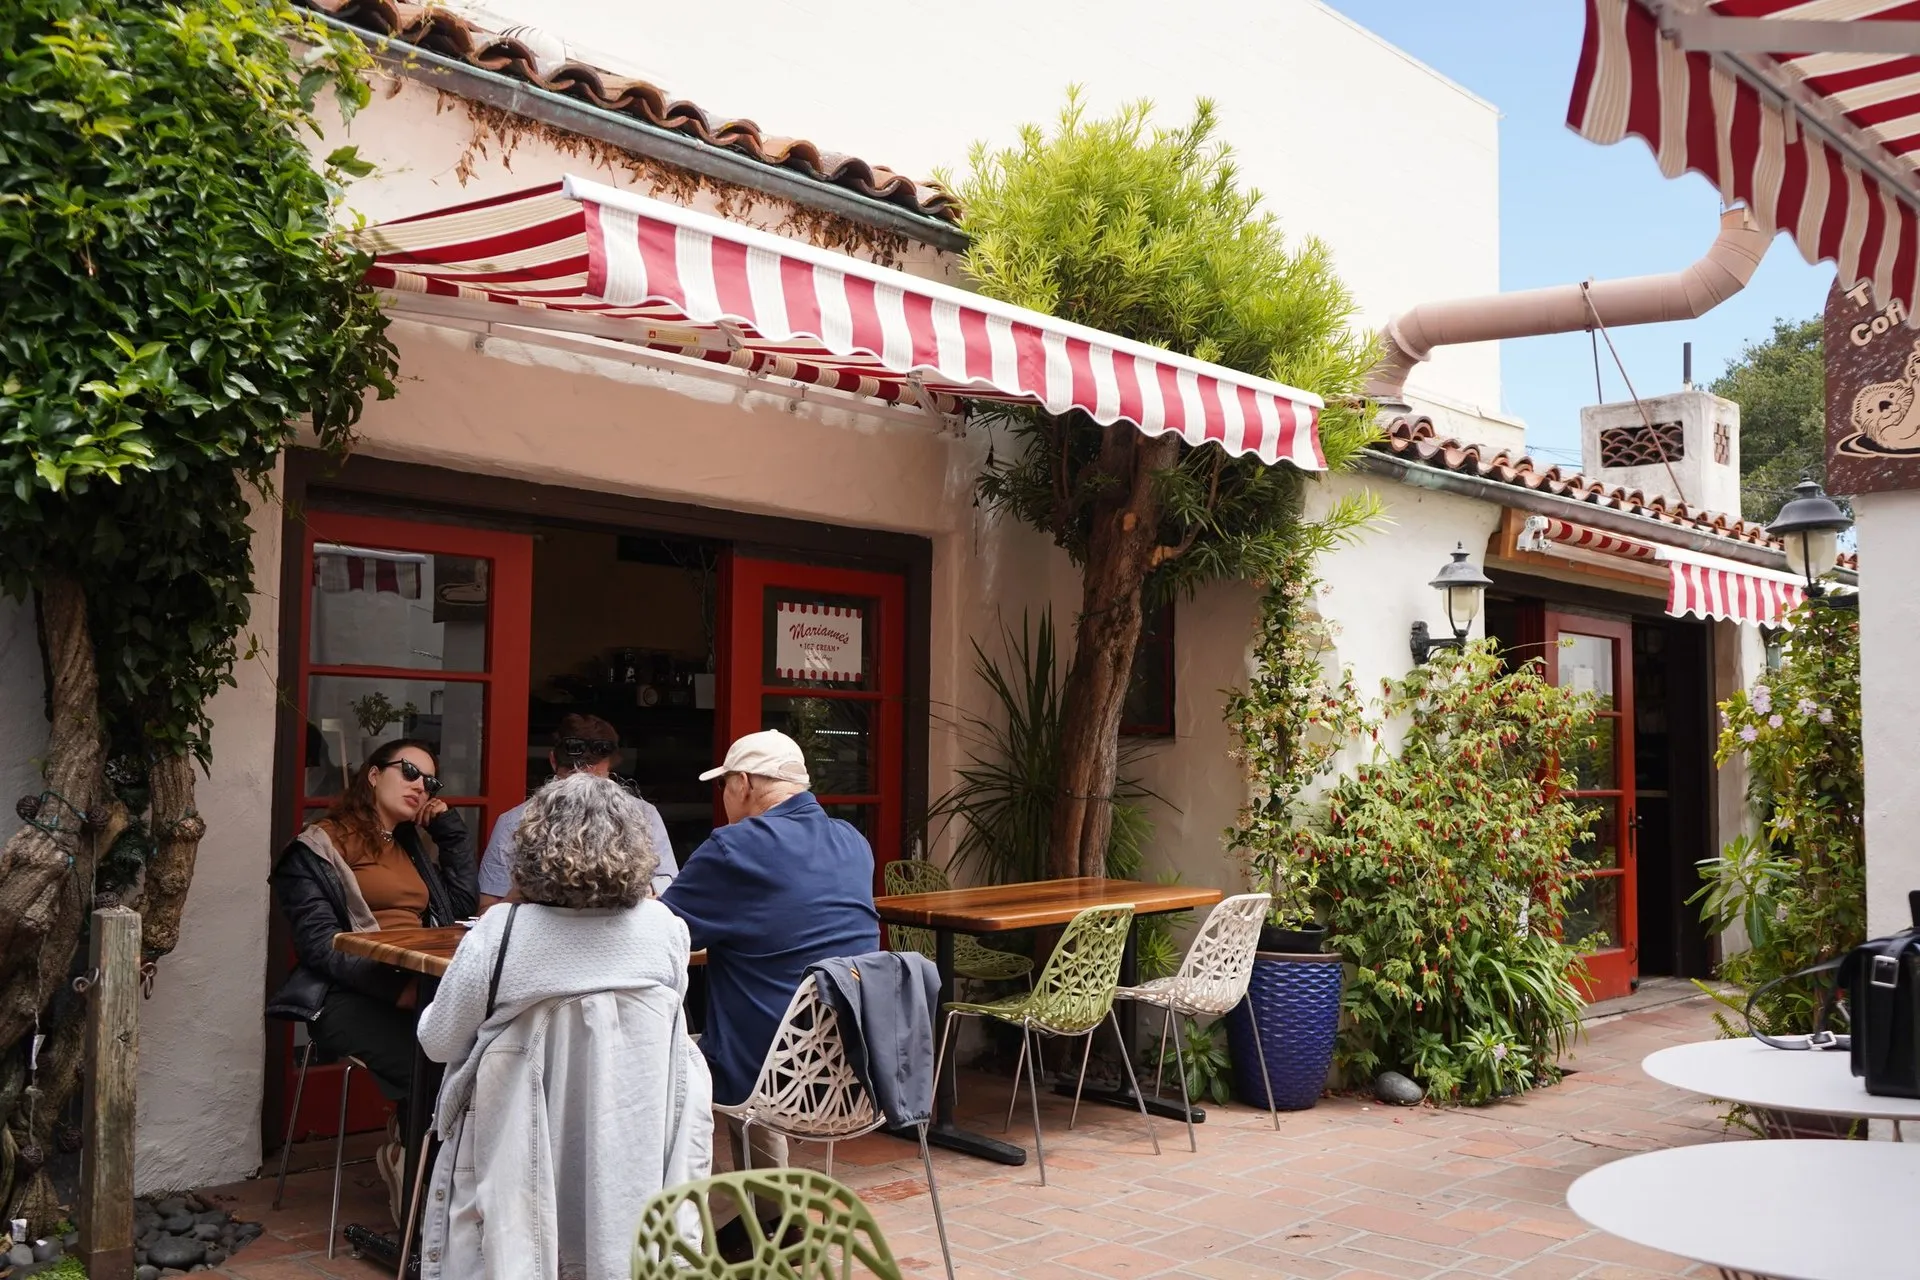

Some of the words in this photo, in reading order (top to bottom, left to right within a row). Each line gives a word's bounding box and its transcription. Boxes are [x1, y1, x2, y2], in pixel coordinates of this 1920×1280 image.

[789, 623, 850, 645] Marianne's
[804, 643, 815, 651] ICE
[816, 643, 836, 652] CREAM
